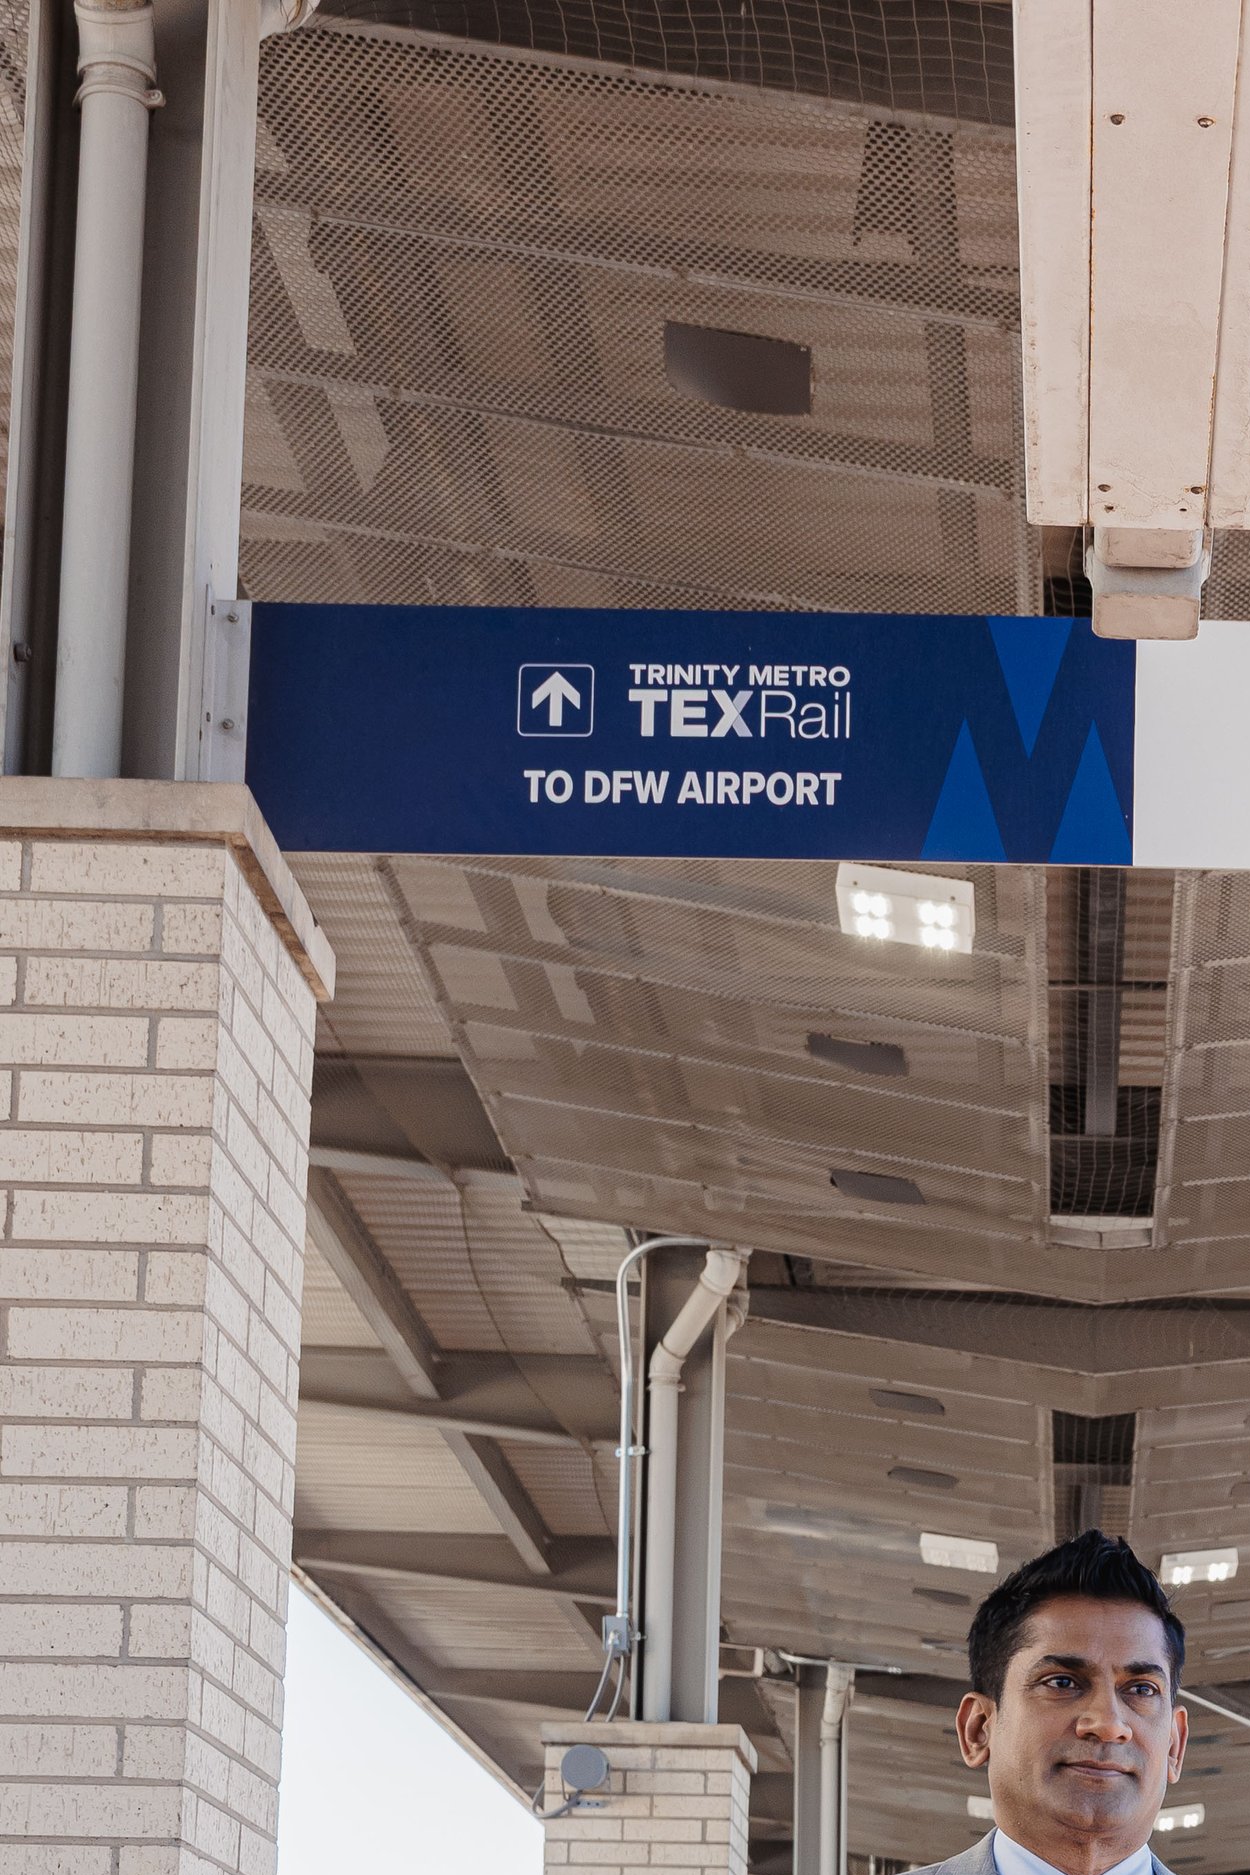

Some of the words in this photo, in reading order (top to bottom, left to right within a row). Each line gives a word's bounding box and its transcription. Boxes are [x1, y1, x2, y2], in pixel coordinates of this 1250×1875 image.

[629, 664, 741, 686] TRINITY
[748, 665, 851, 687] METRO
[628, 688, 851, 739] TEXRail
[523, 769, 574, 804] TO
[584, 770, 670, 804] DFW
[677, 771, 842, 806] AIRPORT
